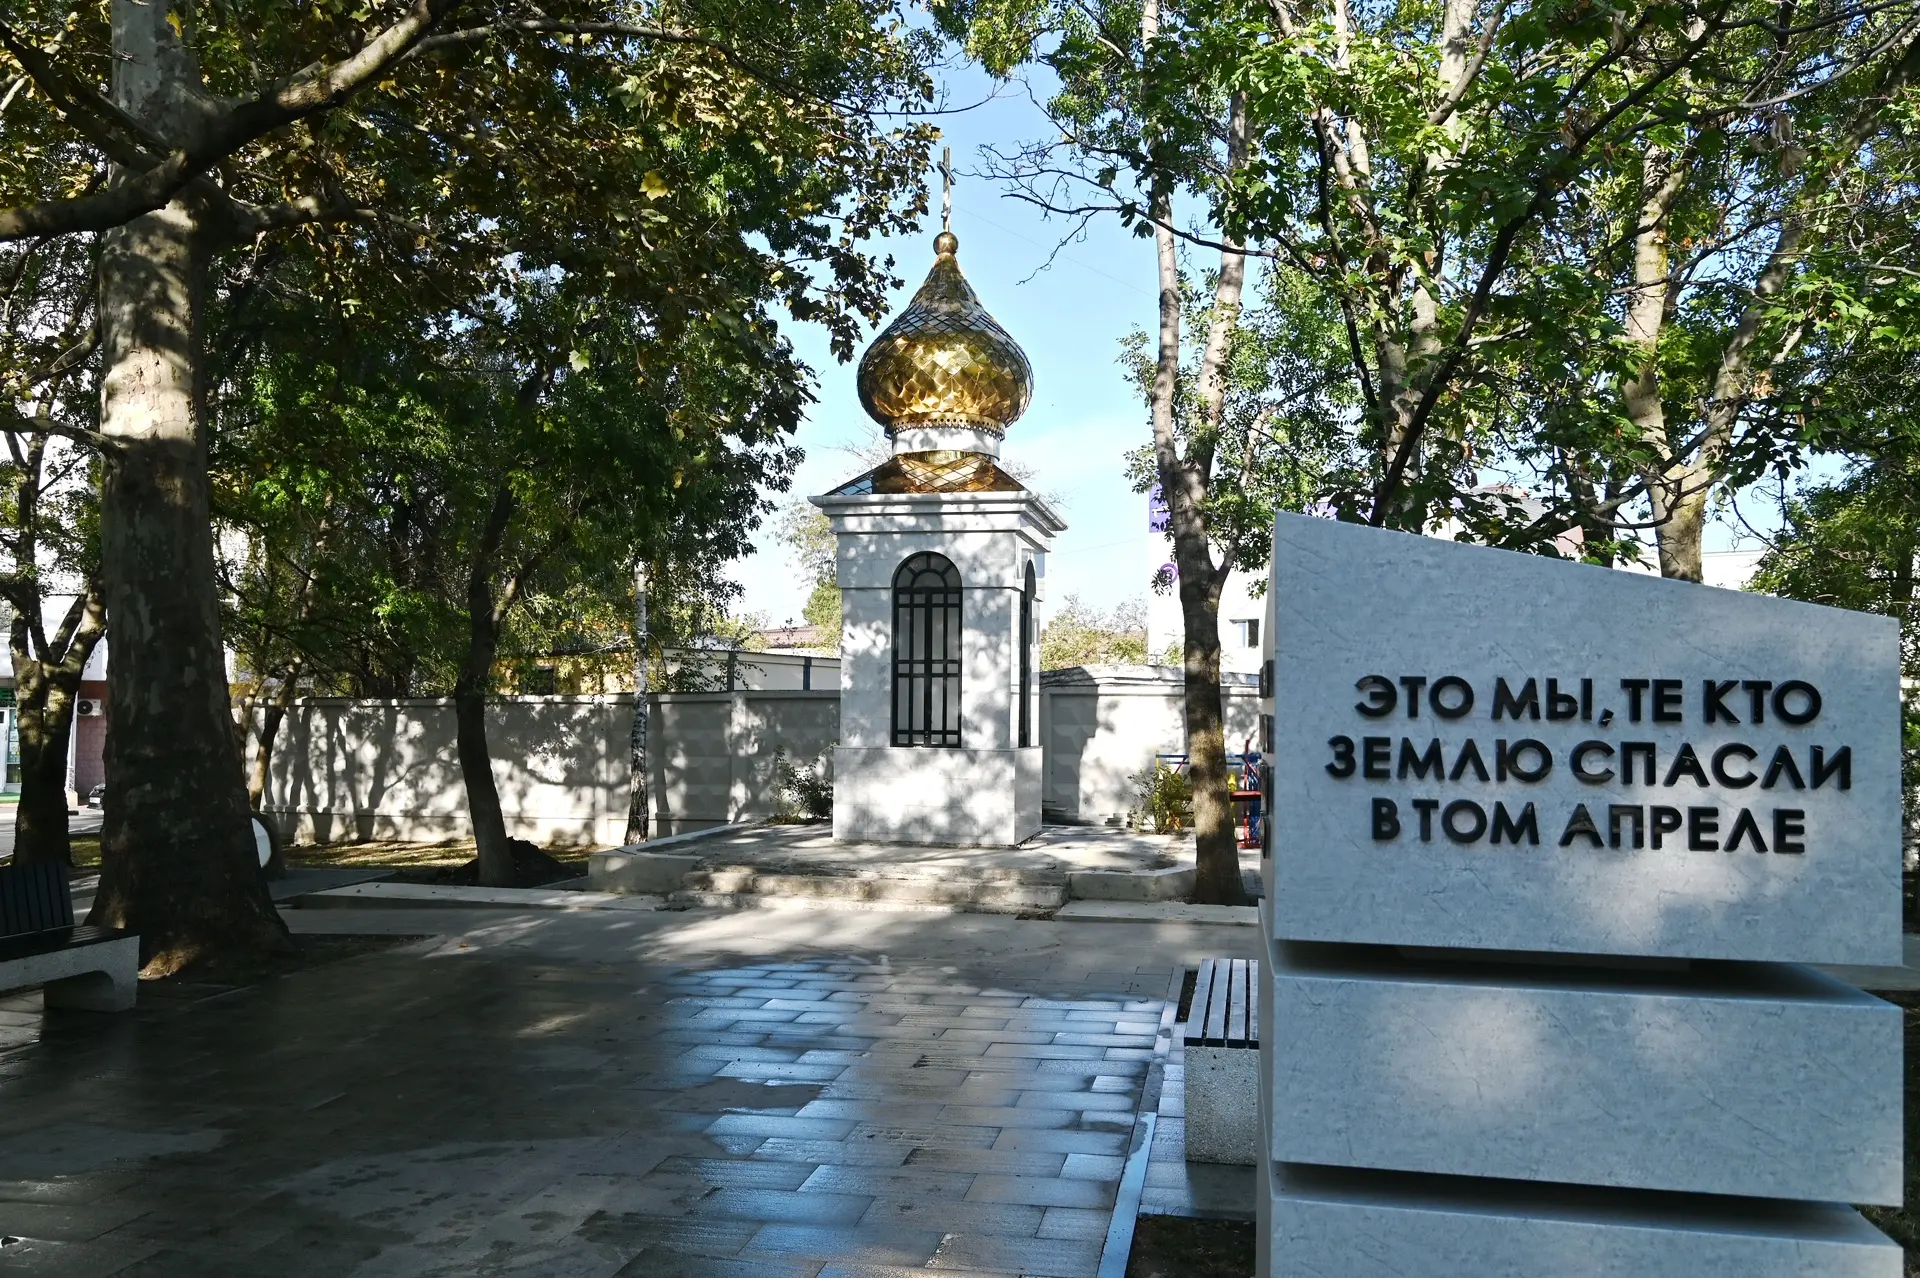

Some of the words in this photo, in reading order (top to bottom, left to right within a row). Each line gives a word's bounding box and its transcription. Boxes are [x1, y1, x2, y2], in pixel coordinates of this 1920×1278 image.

[1354, 674, 1475, 722] ЭТО
[1702, 679, 1823, 729] КТО
[1324, 734, 1554, 785] ЗЕМЛЮ
[1569, 739, 1852, 793] СПАСЛИ
[1371, 797, 1401, 844] В
[1411, 798, 1540, 848] ТОМ
[1558, 803, 1806, 855] АПРЕЛЕ
